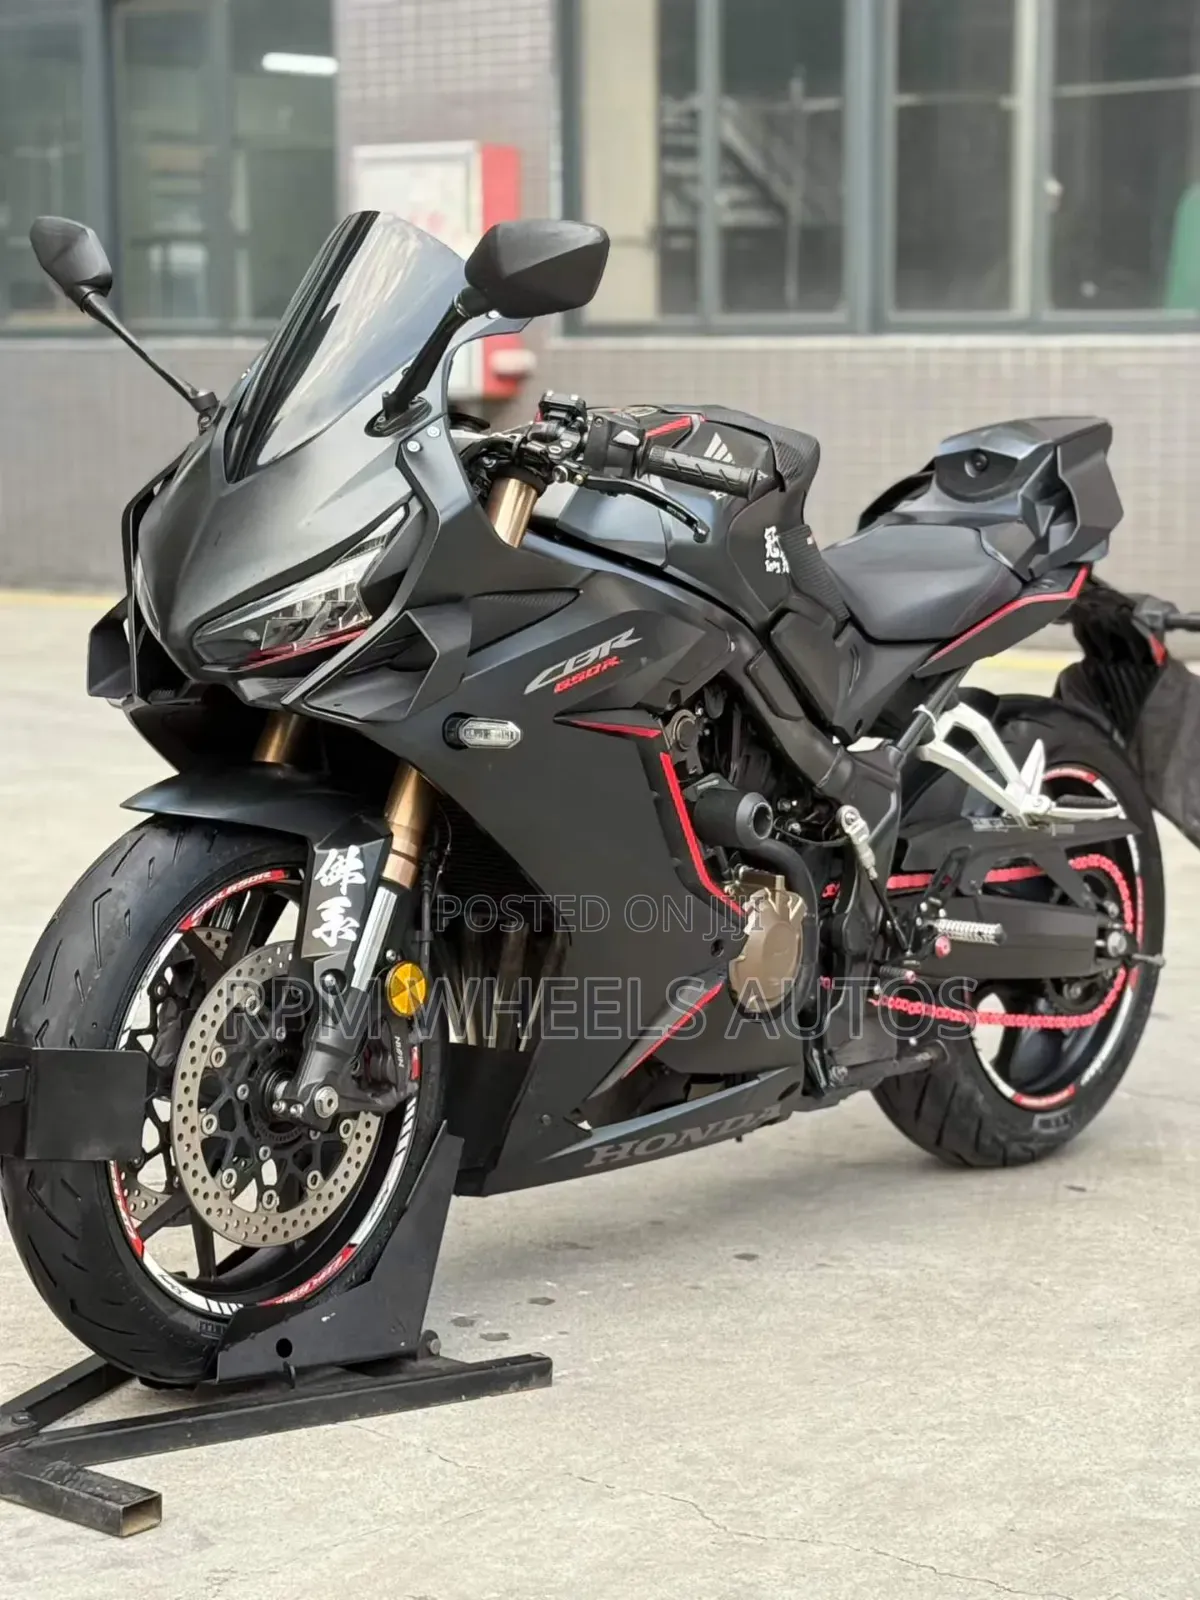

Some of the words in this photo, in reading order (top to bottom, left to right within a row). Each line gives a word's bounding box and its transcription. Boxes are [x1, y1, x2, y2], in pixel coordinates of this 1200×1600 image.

[524, 627, 642, 694] CBR
[553, 656, 622, 693] 650R
[584, 1103, 782, 1168] HONDA
